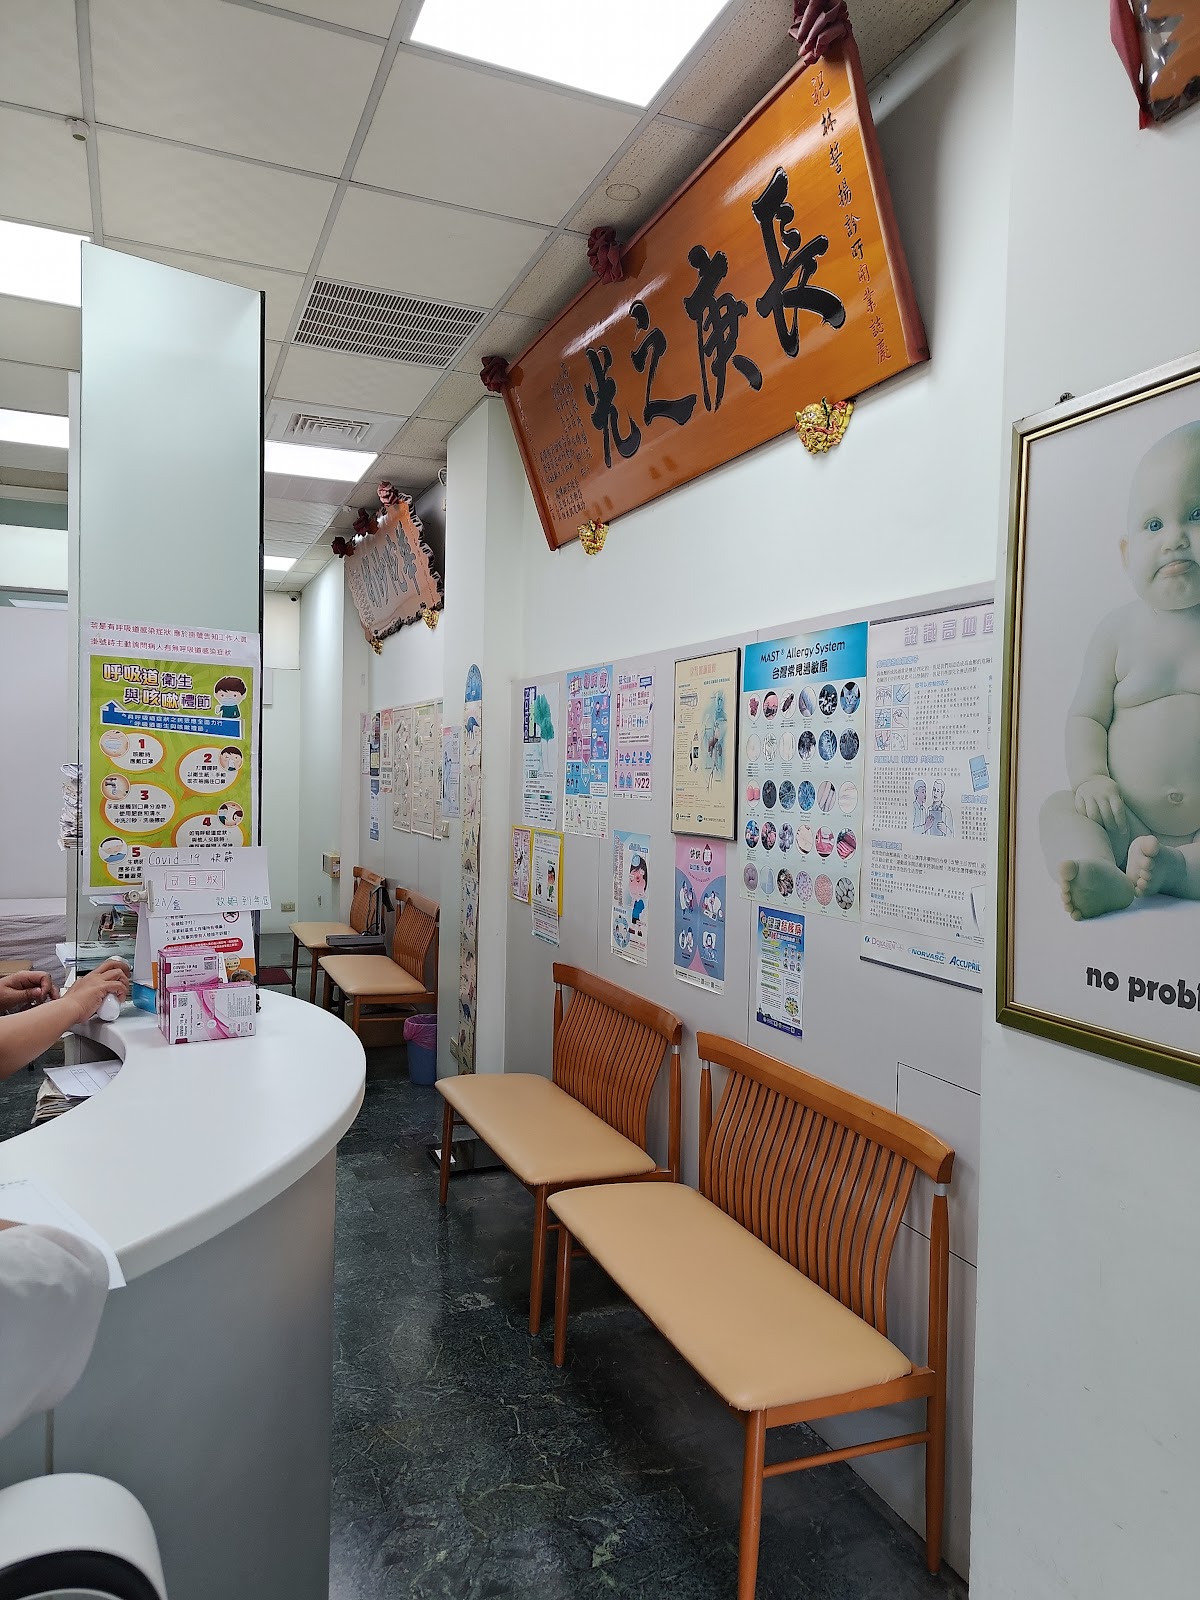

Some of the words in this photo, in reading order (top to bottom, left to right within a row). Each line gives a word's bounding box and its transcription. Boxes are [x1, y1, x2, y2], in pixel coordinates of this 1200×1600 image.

[584, 166, 846, 468] 長庚之光
[786, 642, 814, 660] Allergy
[815, 639, 846, 656] System
[103, 663, 193, 690] 呼吸道衛生
[772, 659, 829, 680] 台灣常見過敏原
[124, 687, 212, 710] 與咳嗽禮節
[138, 739, 145, 749] 1
[203, 753, 212, 763] 2
[140, 790, 149, 800] 3
[202, 817, 212, 827] 4
[131, 847, 141, 857] 5
[1086, 966, 1120, 992] no
